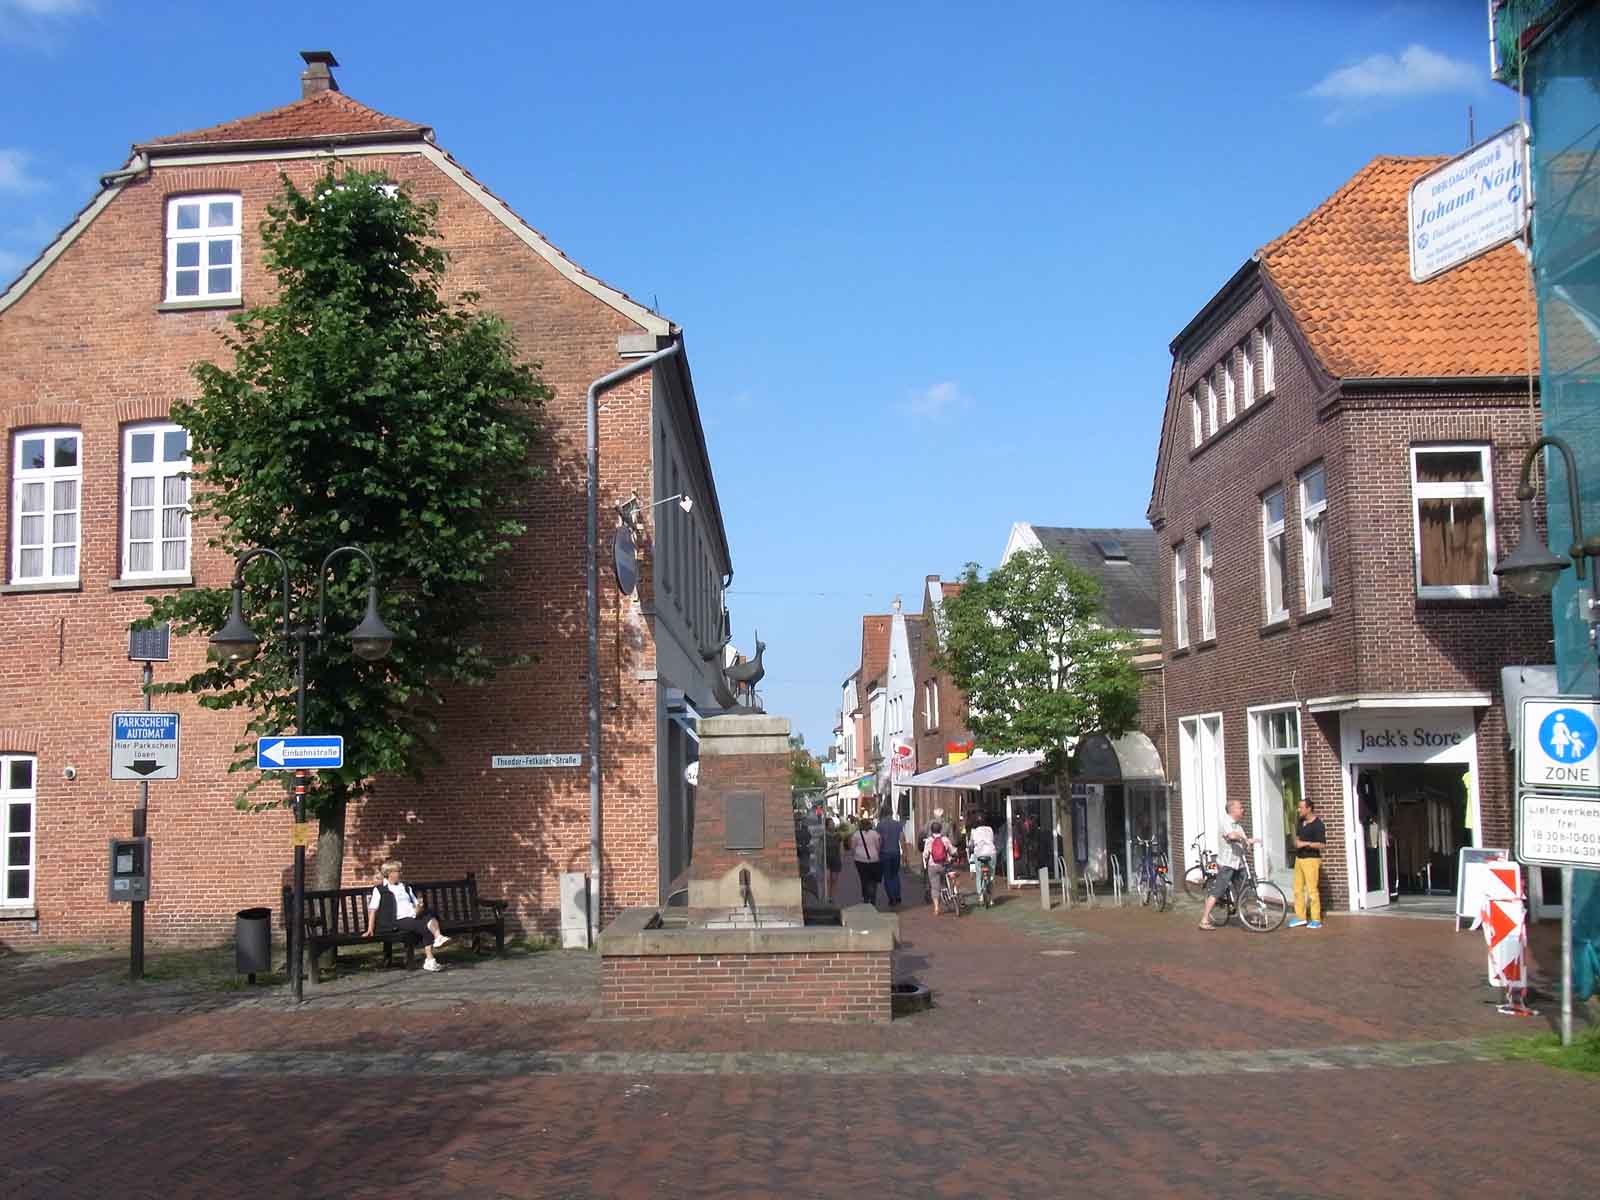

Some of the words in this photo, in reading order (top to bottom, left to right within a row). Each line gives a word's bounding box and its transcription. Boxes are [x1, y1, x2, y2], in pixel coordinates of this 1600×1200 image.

[1416, 187, 1475, 229] Johann
[118, 717, 175, 728] PARKSCHEIN-
[126, 728, 166, 739] AUTOMAT
[1357, 729, 1408, 752] Jack's
[1413, 728, 1462, 746] Store
[282, 748, 338, 757] Einbahnstraße
[1545, 767, 1591, 781] ZONE
[1528, 805, 1600, 817] Lieferverkeh
[1557, 818, 1577, 829] frei
